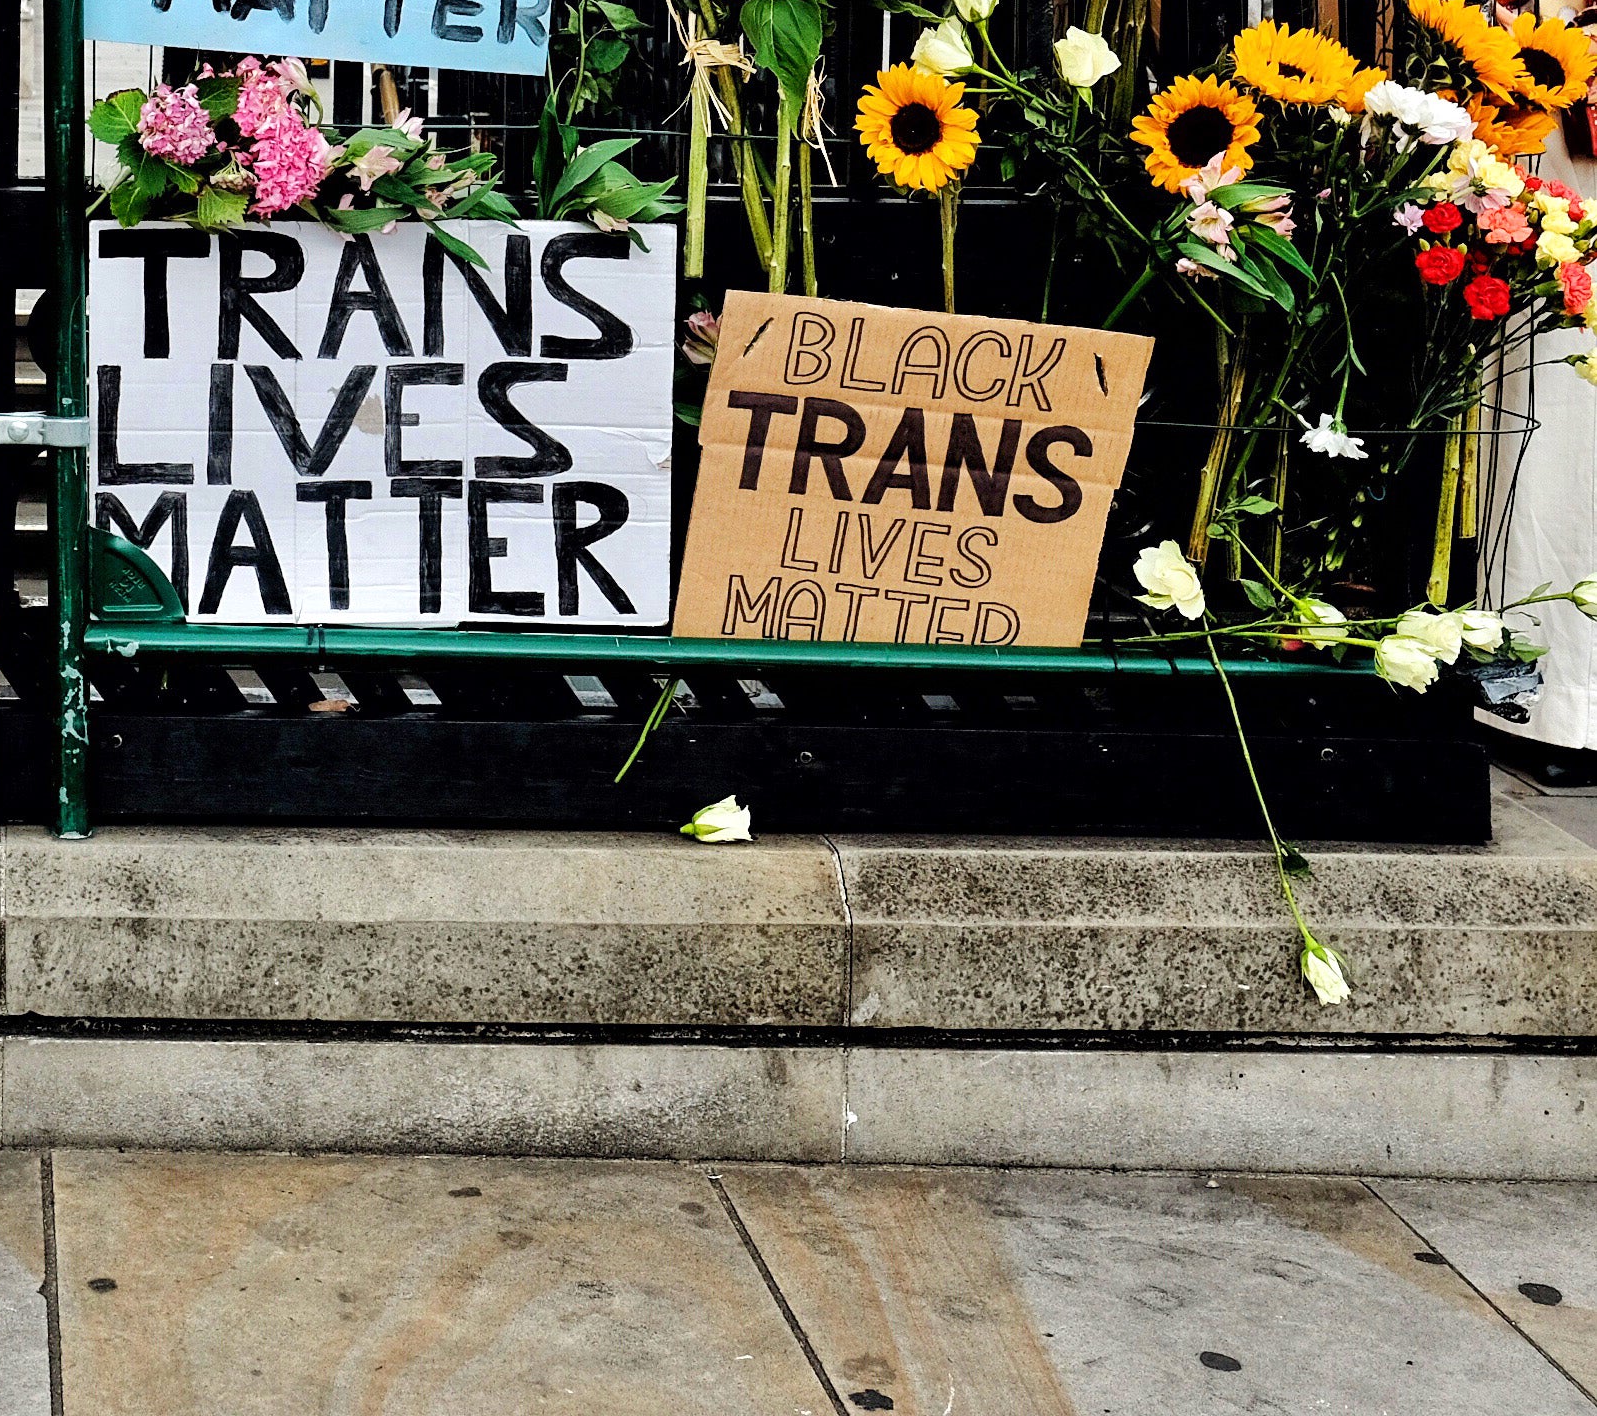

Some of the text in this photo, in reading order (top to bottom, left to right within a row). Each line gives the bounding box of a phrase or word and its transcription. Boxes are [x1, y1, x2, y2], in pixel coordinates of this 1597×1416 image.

[98, 227, 635, 361] TRANS
[97, 361, 574, 486] LIVES
[784, 311, 1067, 412] BLACK
[727, 390, 1094, 524] TRANS
[94, 479, 639, 617] MATTER
[781, 507, 999, 589] LIVES
